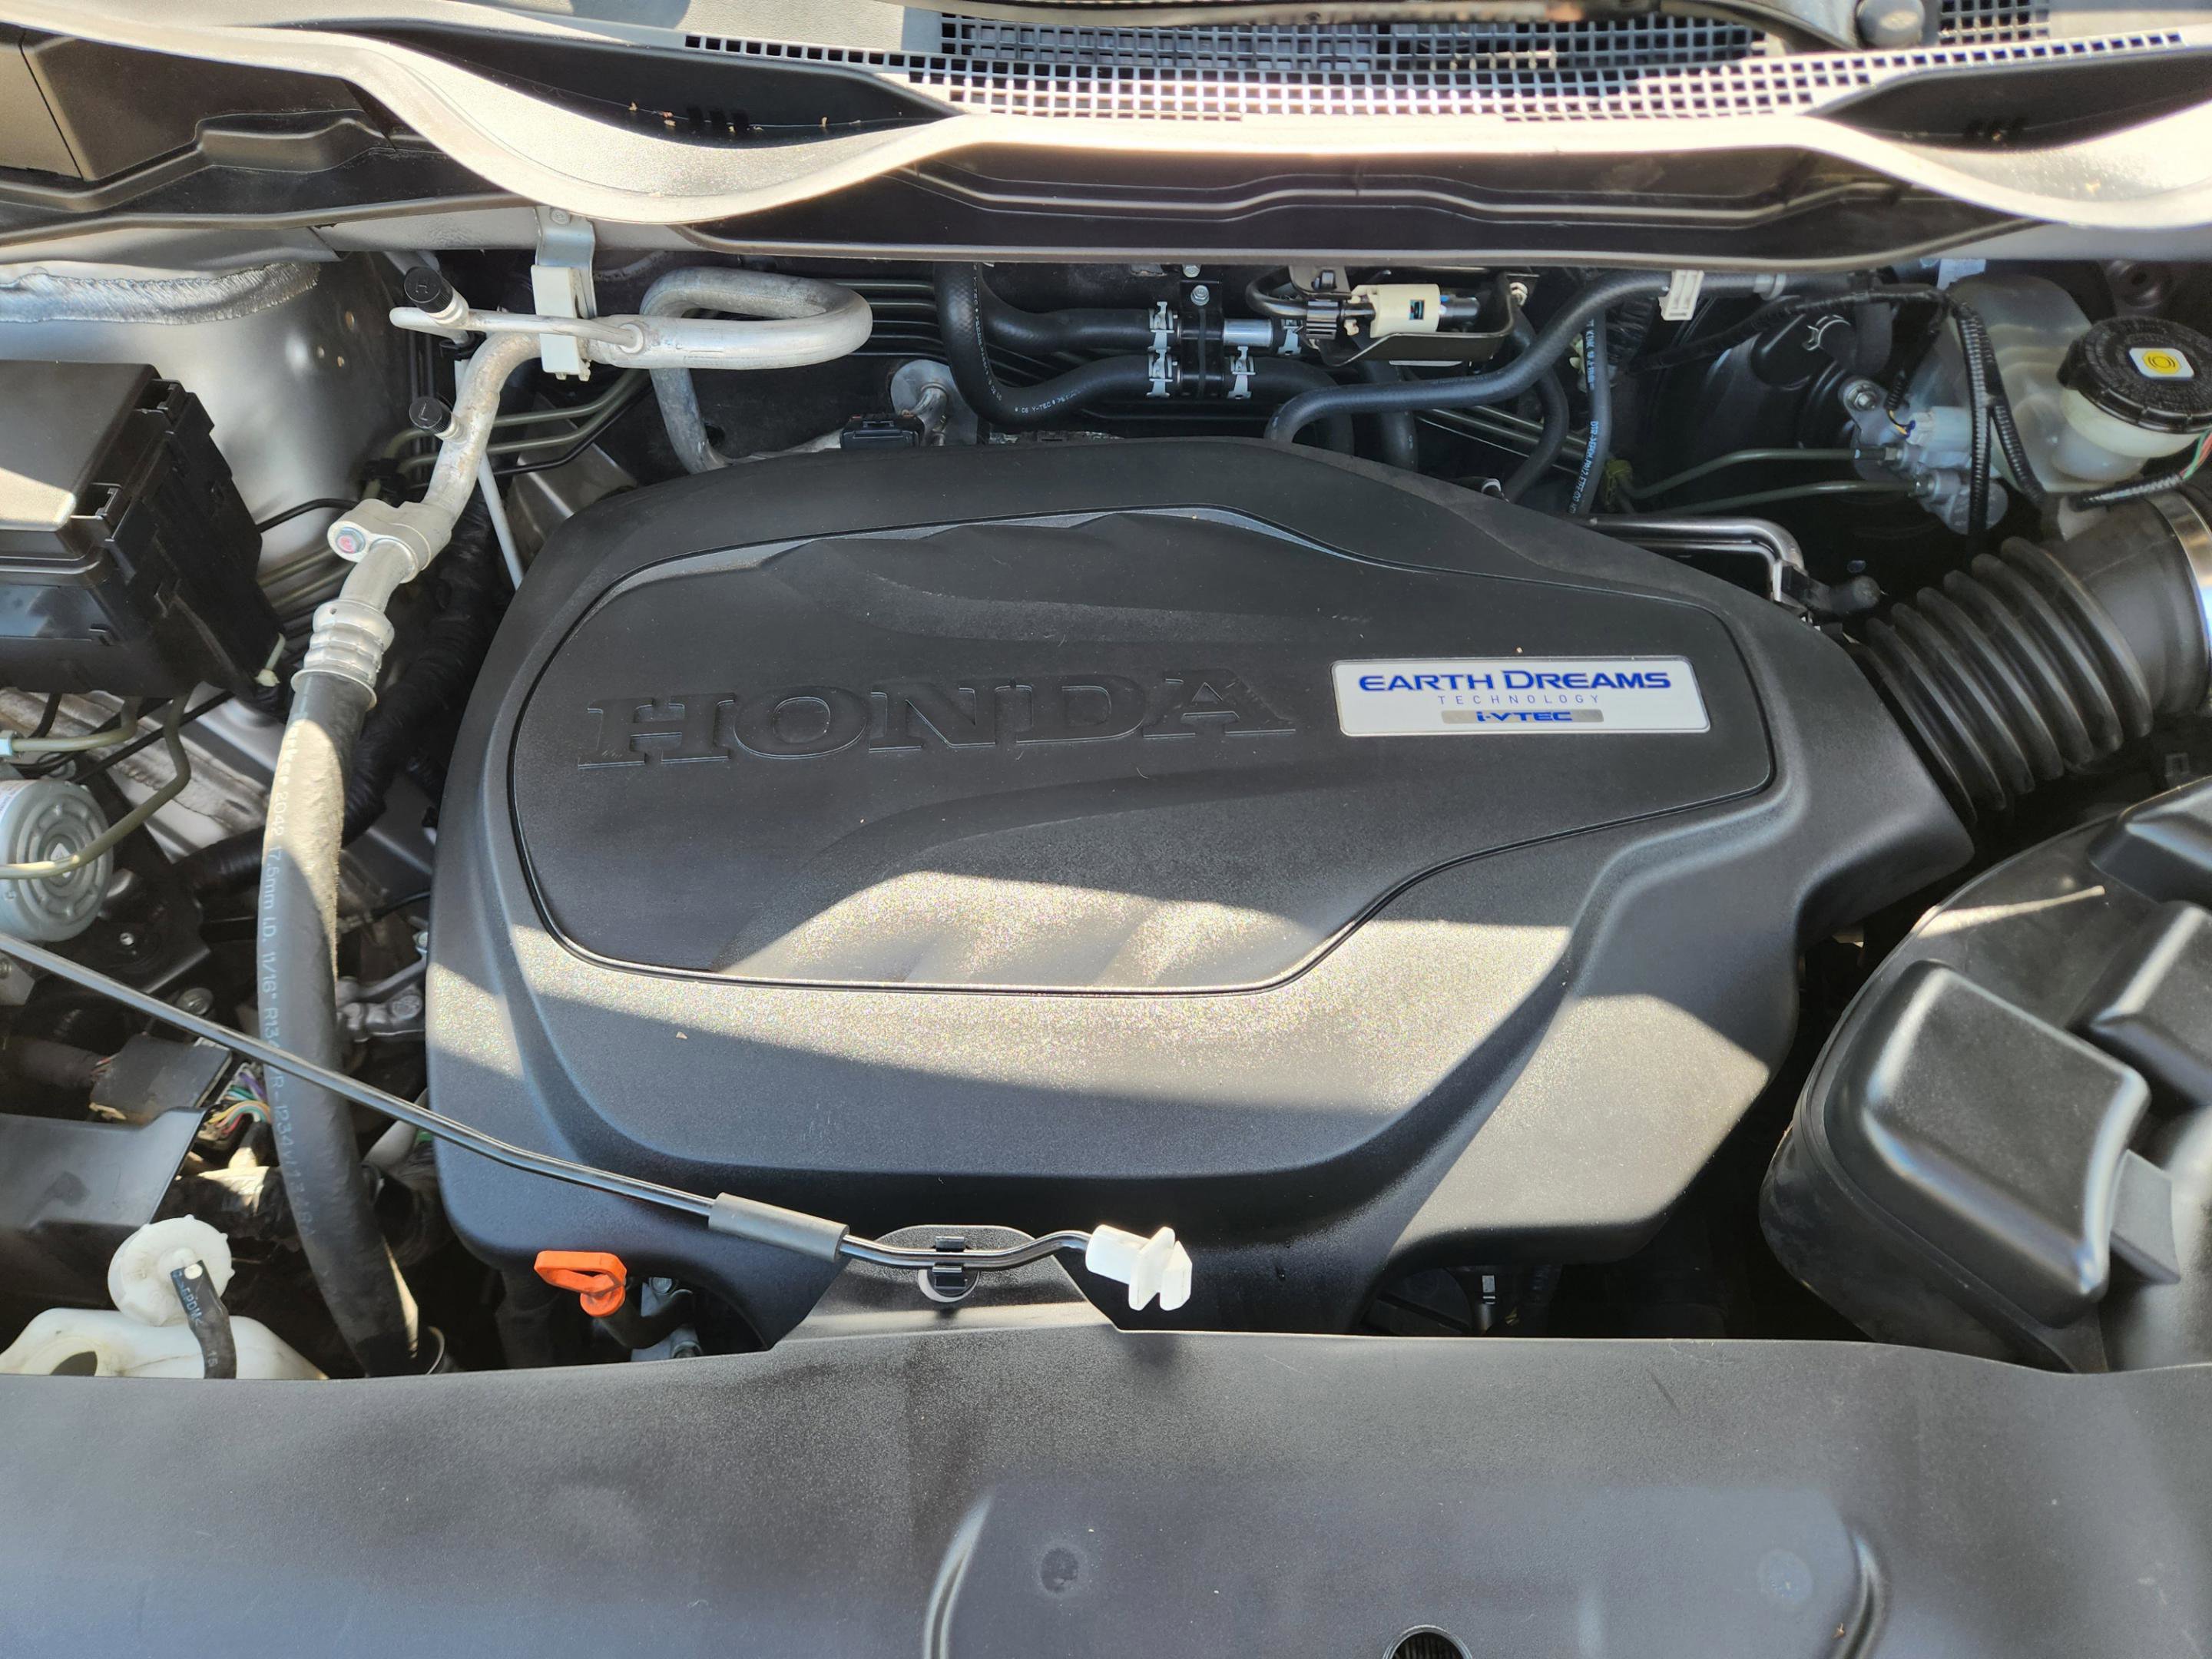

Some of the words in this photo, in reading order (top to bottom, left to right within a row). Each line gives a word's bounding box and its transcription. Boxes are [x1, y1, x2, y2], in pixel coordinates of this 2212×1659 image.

[1359, 674, 1494, 691] EARTH
[1502, 670, 1671, 690] DREAMS
[1437, 694, 1600, 705] TECHNOLOGY
[578, 670, 1296, 767] HONDA
[270, 791, 289, 836] 2042
[262, 952, 277, 999] 11/16"
